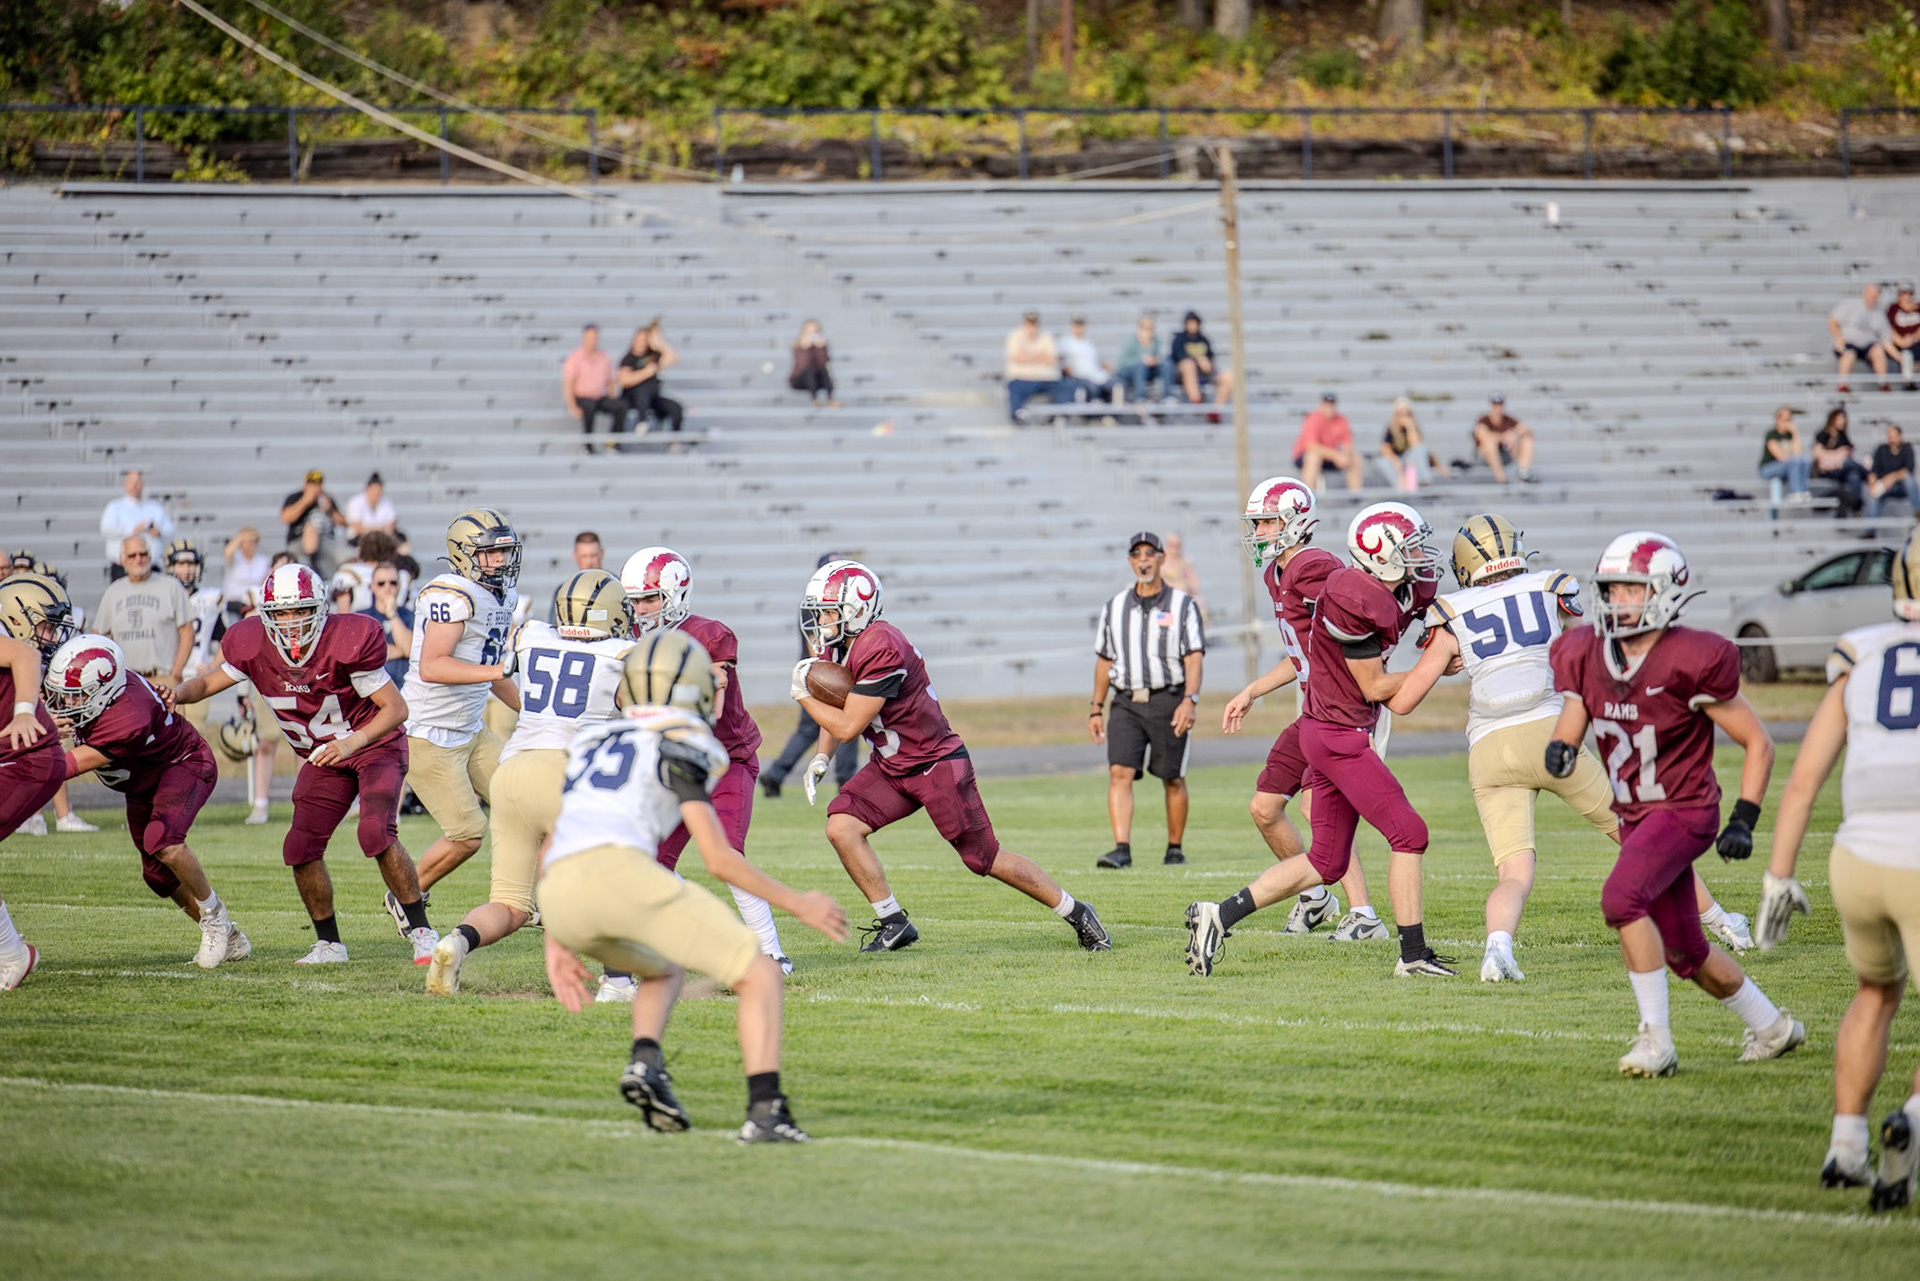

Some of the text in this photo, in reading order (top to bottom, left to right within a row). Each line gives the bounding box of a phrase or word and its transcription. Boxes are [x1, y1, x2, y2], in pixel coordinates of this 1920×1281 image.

[1485, 558, 1521, 574] Riddell
[430, 602, 451, 623] 66
[559, 627, 591, 637] Riddell
[1462, 591, 1552, 660] 50
[1276, 617, 1311, 683] 9
[524, 647, 597, 719] 58
[1604, 701, 1639, 720] RAMS
[262, 693, 355, 750] 54
[1593, 717, 1667, 804] 21
